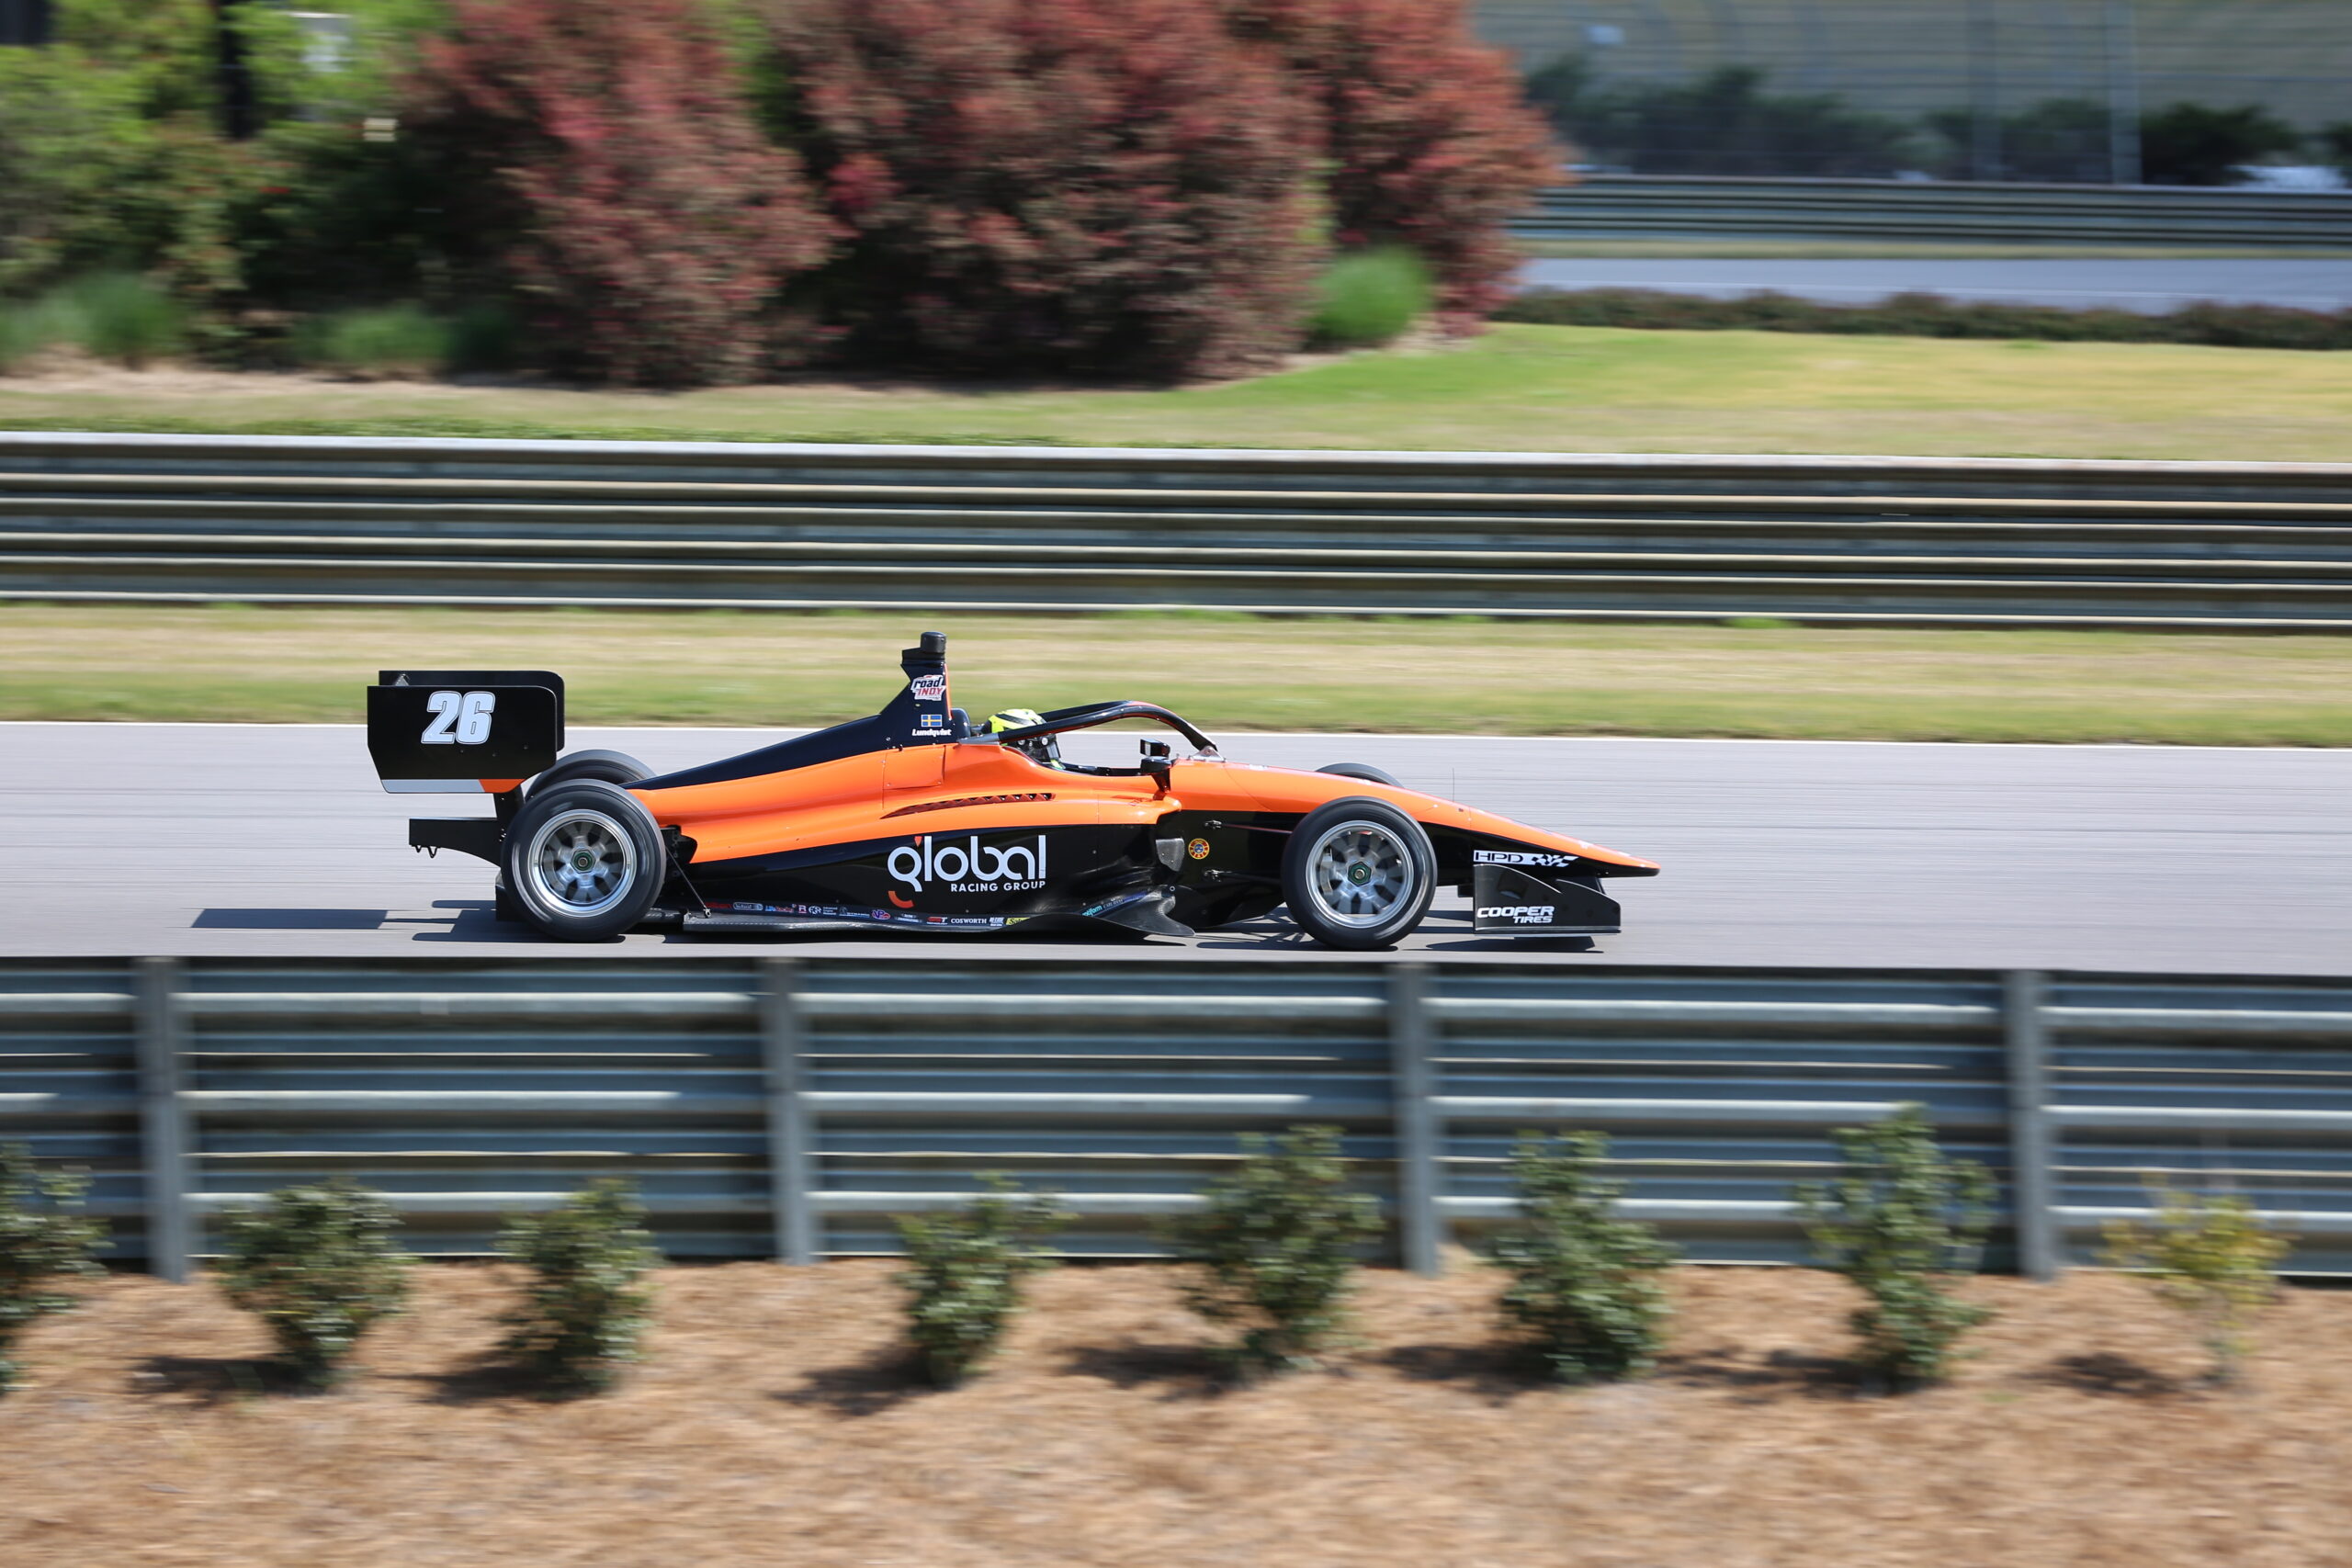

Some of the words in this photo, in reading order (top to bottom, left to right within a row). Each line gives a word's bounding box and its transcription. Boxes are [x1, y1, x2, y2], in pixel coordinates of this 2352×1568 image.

[914, 677, 942, 688] road
[918, 688, 943, 696] INDY
[420, 691, 496, 745] 26
[911, 728, 952, 738] Lundqvist
[1476, 852, 1523, 863] HPD
[888, 835, 1046, 908] global
[951, 883, 999, 892] RACING
[1003, 880, 1046, 891] GROUP
[873, 909, 885, 919] VP
[1476, 906, 1555, 919] COOPER
[1512, 916, 1553, 924] TIRES
